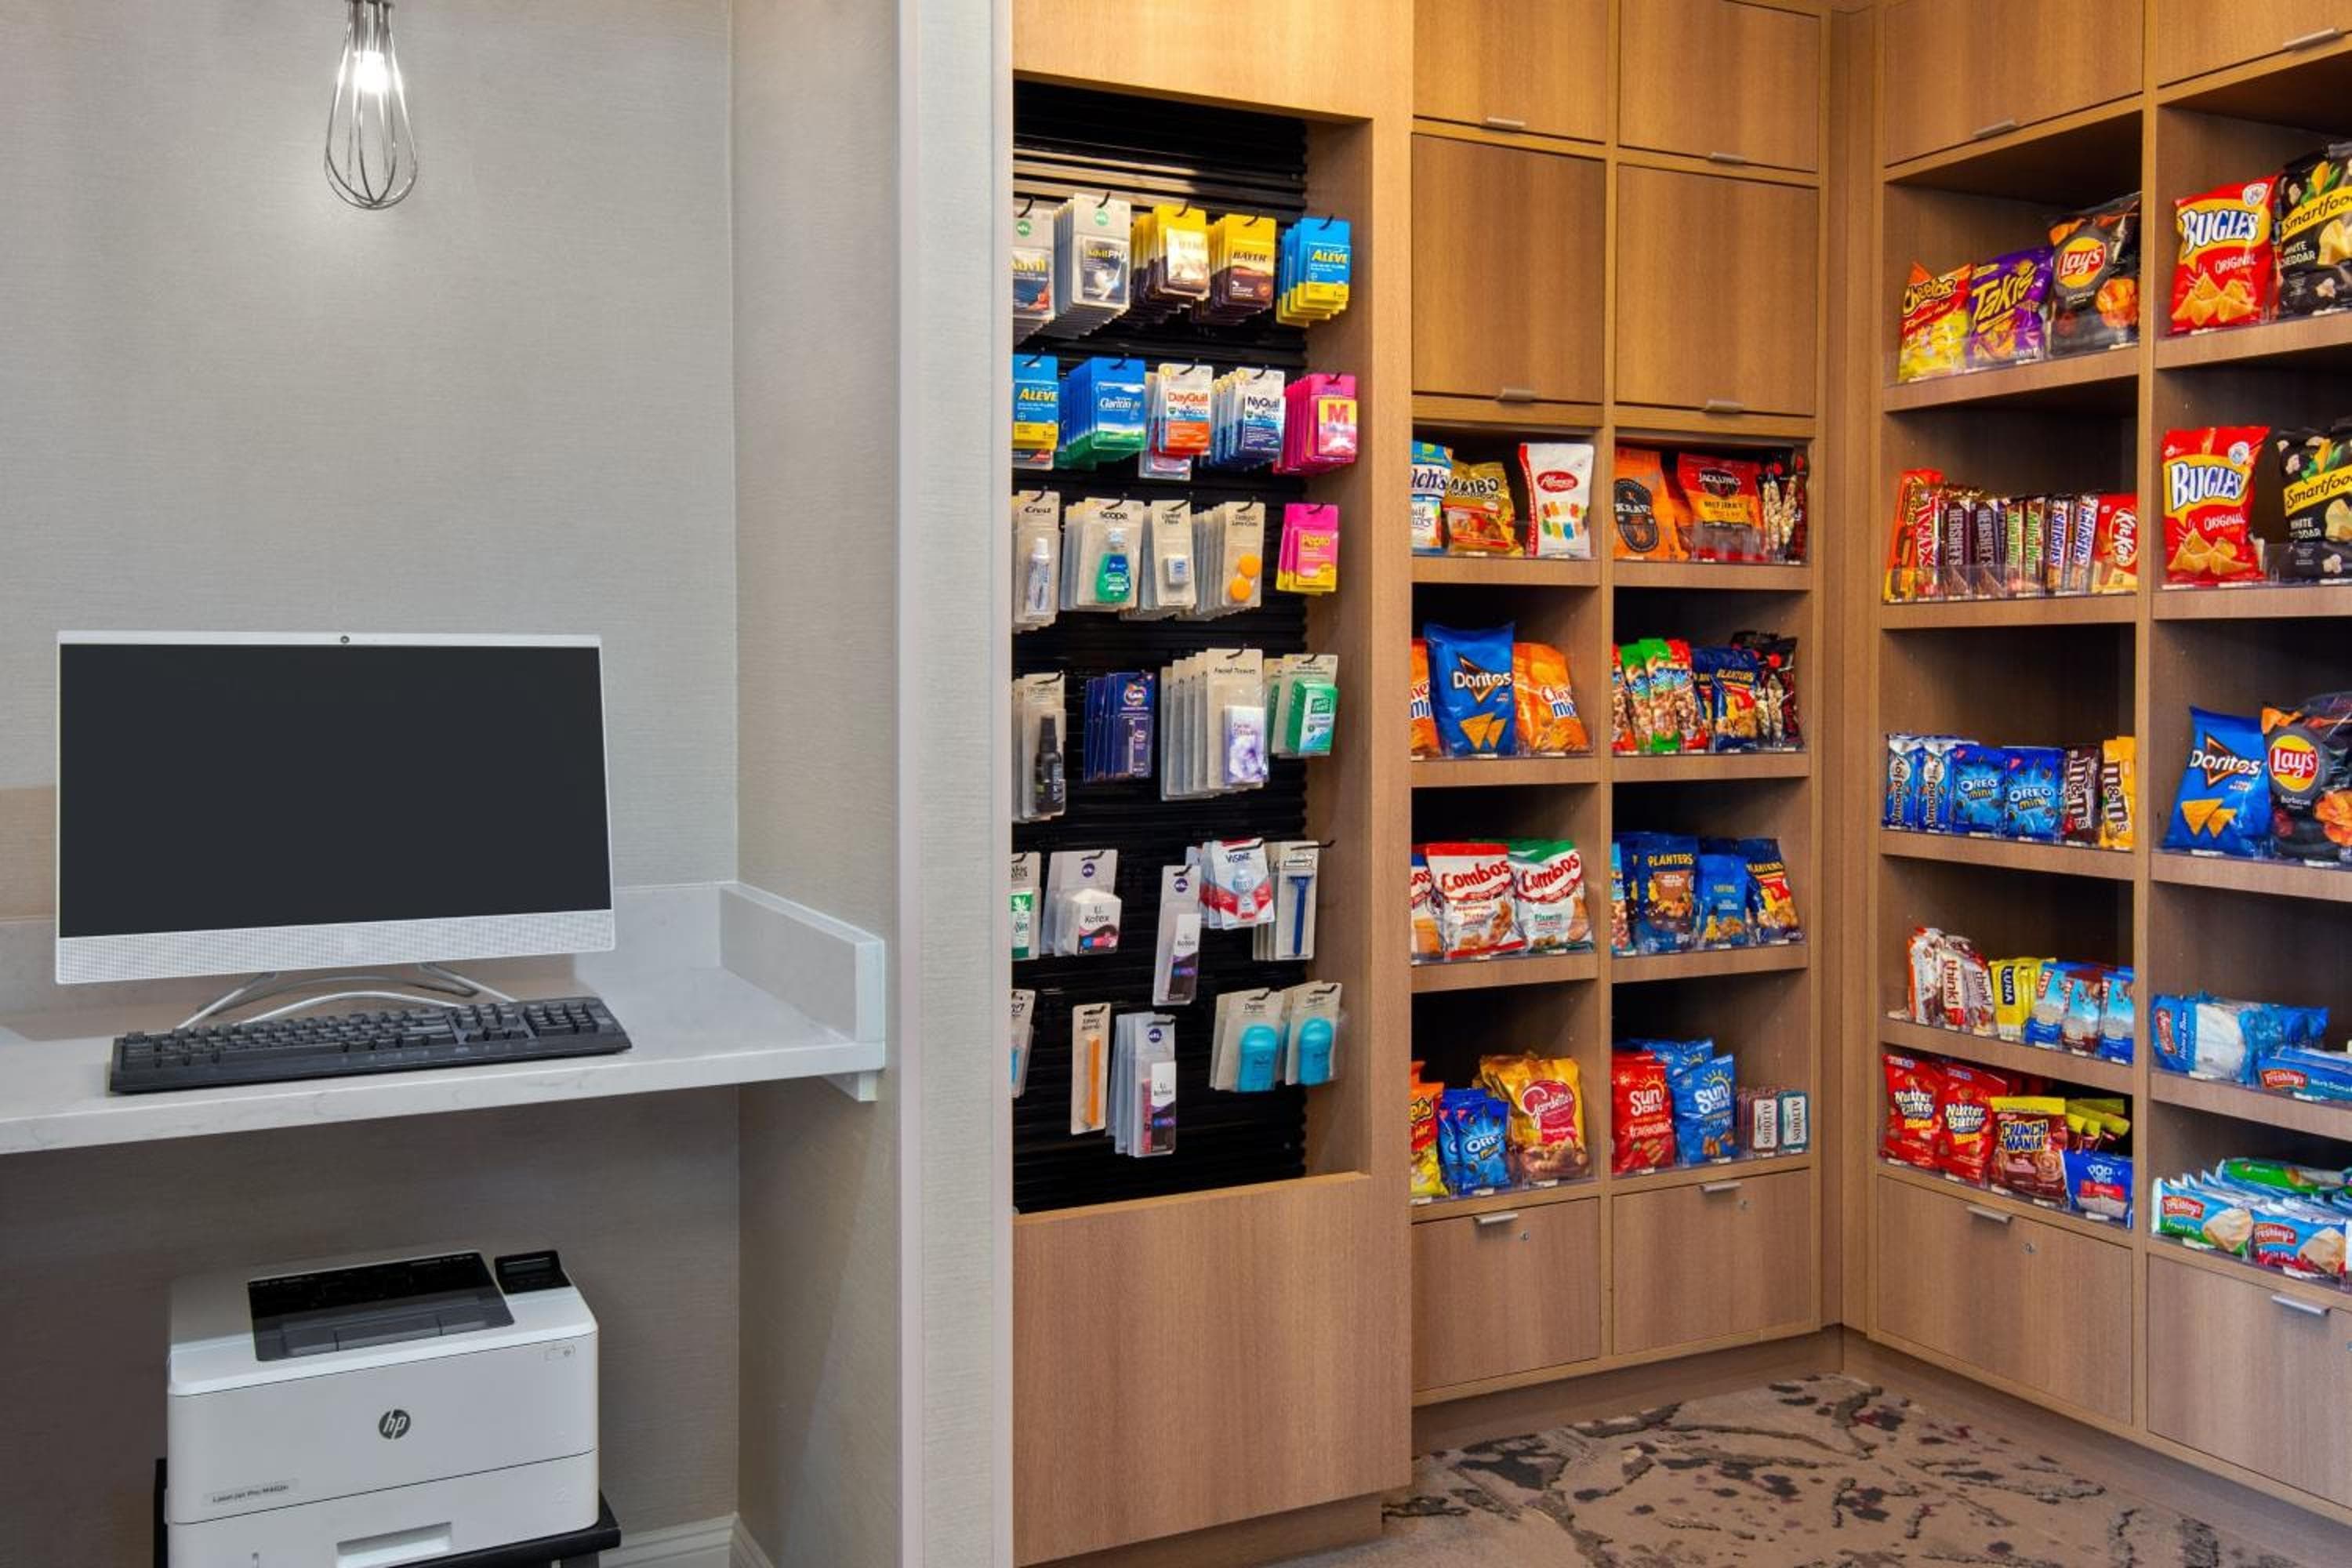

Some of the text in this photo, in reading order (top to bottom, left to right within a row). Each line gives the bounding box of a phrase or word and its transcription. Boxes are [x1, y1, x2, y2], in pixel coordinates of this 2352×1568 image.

[2283, 194, 2352, 235] Smartfoo
[2182, 209, 2258, 255] BUGLES
[1412, 470, 1446, 490] lch's
[2171, 463, 2242, 512] BUGLES
[2287, 474, 2352, 510] Smartfoo
[1453, 670, 1512, 690] Doritos
[2189, 750, 2261, 776] Doritos
[1961, 779, 1998, 791] OREO
[2009, 788, 2052, 802] OREO
[1648, 853, 1694, 867] PLANTERS
[1442, 860, 1511, 892] Combos
[1630, 1088, 1661, 1116] Sun
[1695, 1084, 1727, 1114] Sun
[382, 1409, 408, 1440] hp
